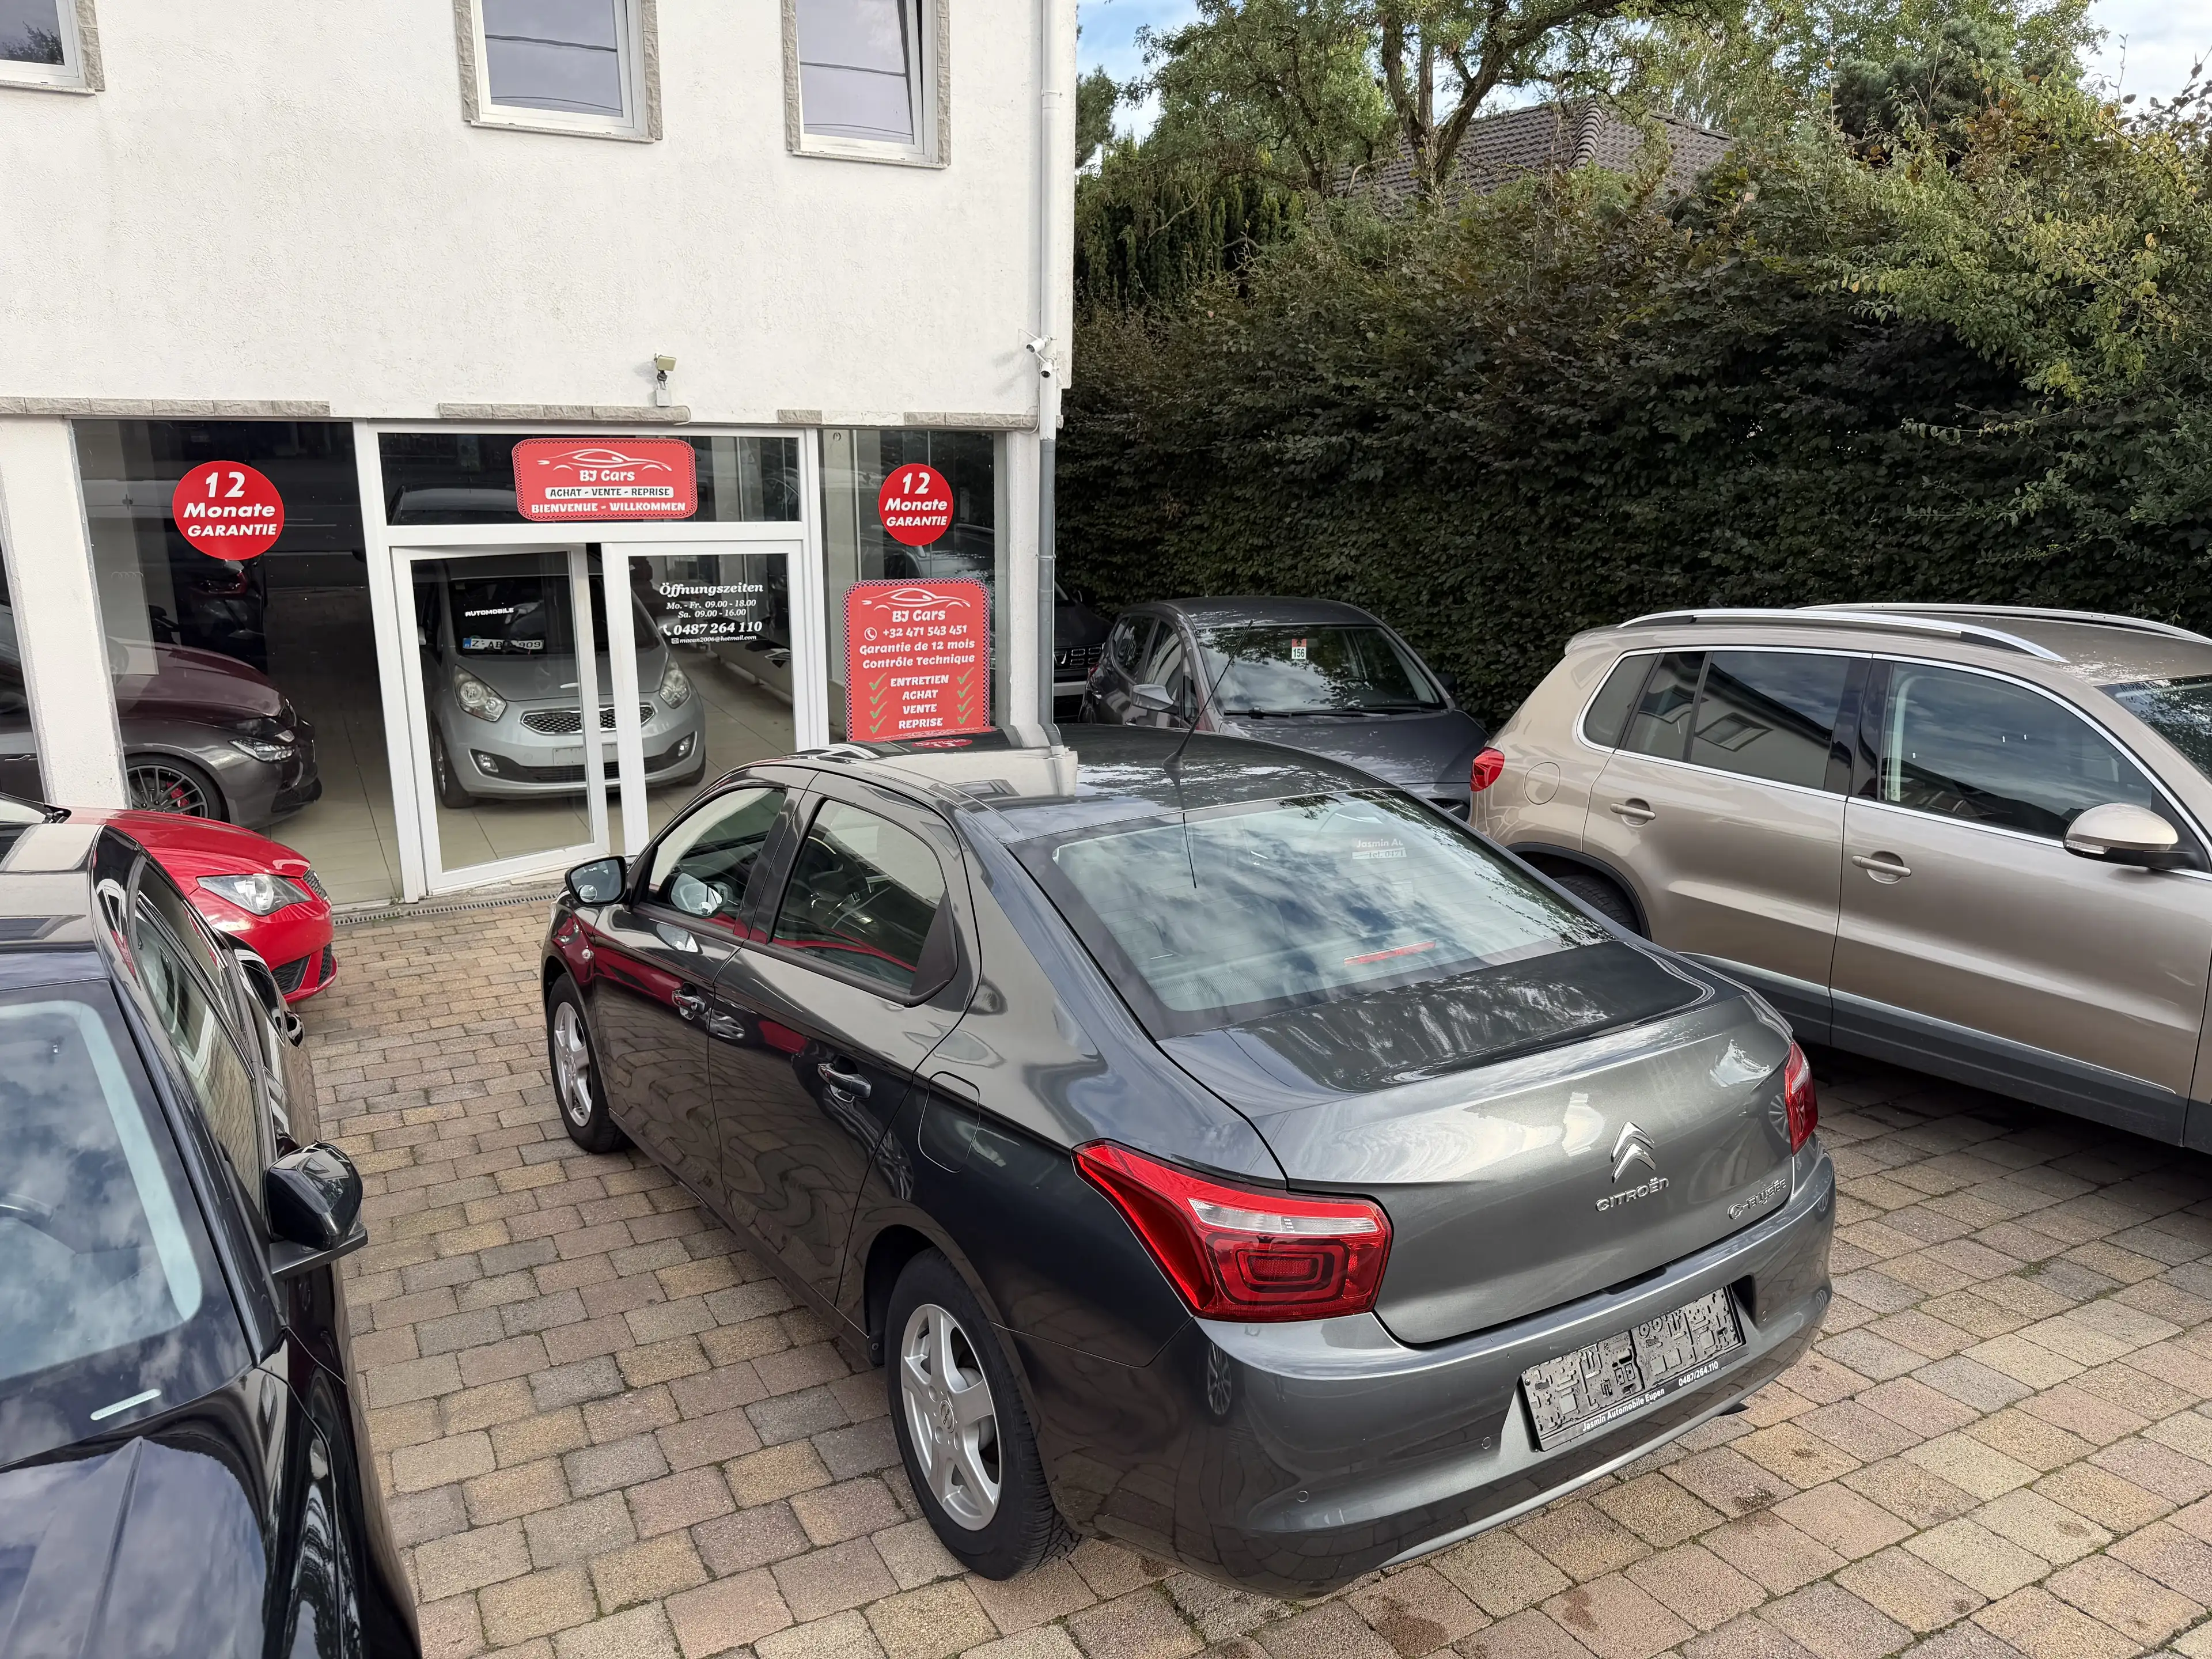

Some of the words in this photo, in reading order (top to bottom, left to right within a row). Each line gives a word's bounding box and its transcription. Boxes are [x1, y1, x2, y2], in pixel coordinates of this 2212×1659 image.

[579, 470, 597, 482] BJ
[601, 470, 635, 482] Cars
[206, 471, 245, 498] 12
[902, 472, 931, 494] 12
[550, 488, 581, 497] ACHAT
[592, 488, 622, 497] VENTE
[631, 488, 670, 496] REPRISE
[183, 502, 275, 518] Monate
[531, 503, 598, 513] BIENVENUE
[609, 502, 685, 512] WILLKOMMEN
[884, 498, 948, 511] Monate
[886, 516, 948, 527] GARANTIE
[187, 524, 277, 537] GARANTIE
[659, 582, 764, 597] Öffnungszeiten
[690, 601, 702, 609] Fr.
[704, 600, 728, 608] 09.00
[734, 599, 757, 607] 18.00
[465, 607, 514, 617] AUTOMOBILE
[694, 609, 717, 618] 09.00
[725, 609, 747, 617] 16.00
[892, 609, 910, 623] BJ
[912, 609, 946, 622] Cars
[673, 623, 708, 636] 0487
[710, 622, 735, 634] 264
[738, 621, 763, 633] 110
[882, 627, 903, 638] +32
[906, 626, 924, 637] 471
[927, 626, 946, 636] 543
[949, 624, 967, 635] 451
[859, 642, 911, 655] Garantie
[914, 642, 929, 651] de
[931, 641, 944, 650] 12
[947, 638, 975, 649] mois
[1293, 648, 1305, 658] 156
[862, 657, 913, 669] Contrôle
[916, 654, 975, 666] Technique
[890, 675, 949, 687] ENTRETIEN
[902, 689, 939, 700] ACHAT
[902, 703, 938, 714] VENTE
[899, 717, 944, 729] REPRISE
[1356, 839, 1389, 848] Jasmin
[1582, 1414, 1607, 1432] Jasmin
[1607, 1396, 1645, 1421] Automobile
[1645, 1388, 1665, 1404] Eupen
[1678, 1361, 1719, 1387] 0487/264.110
